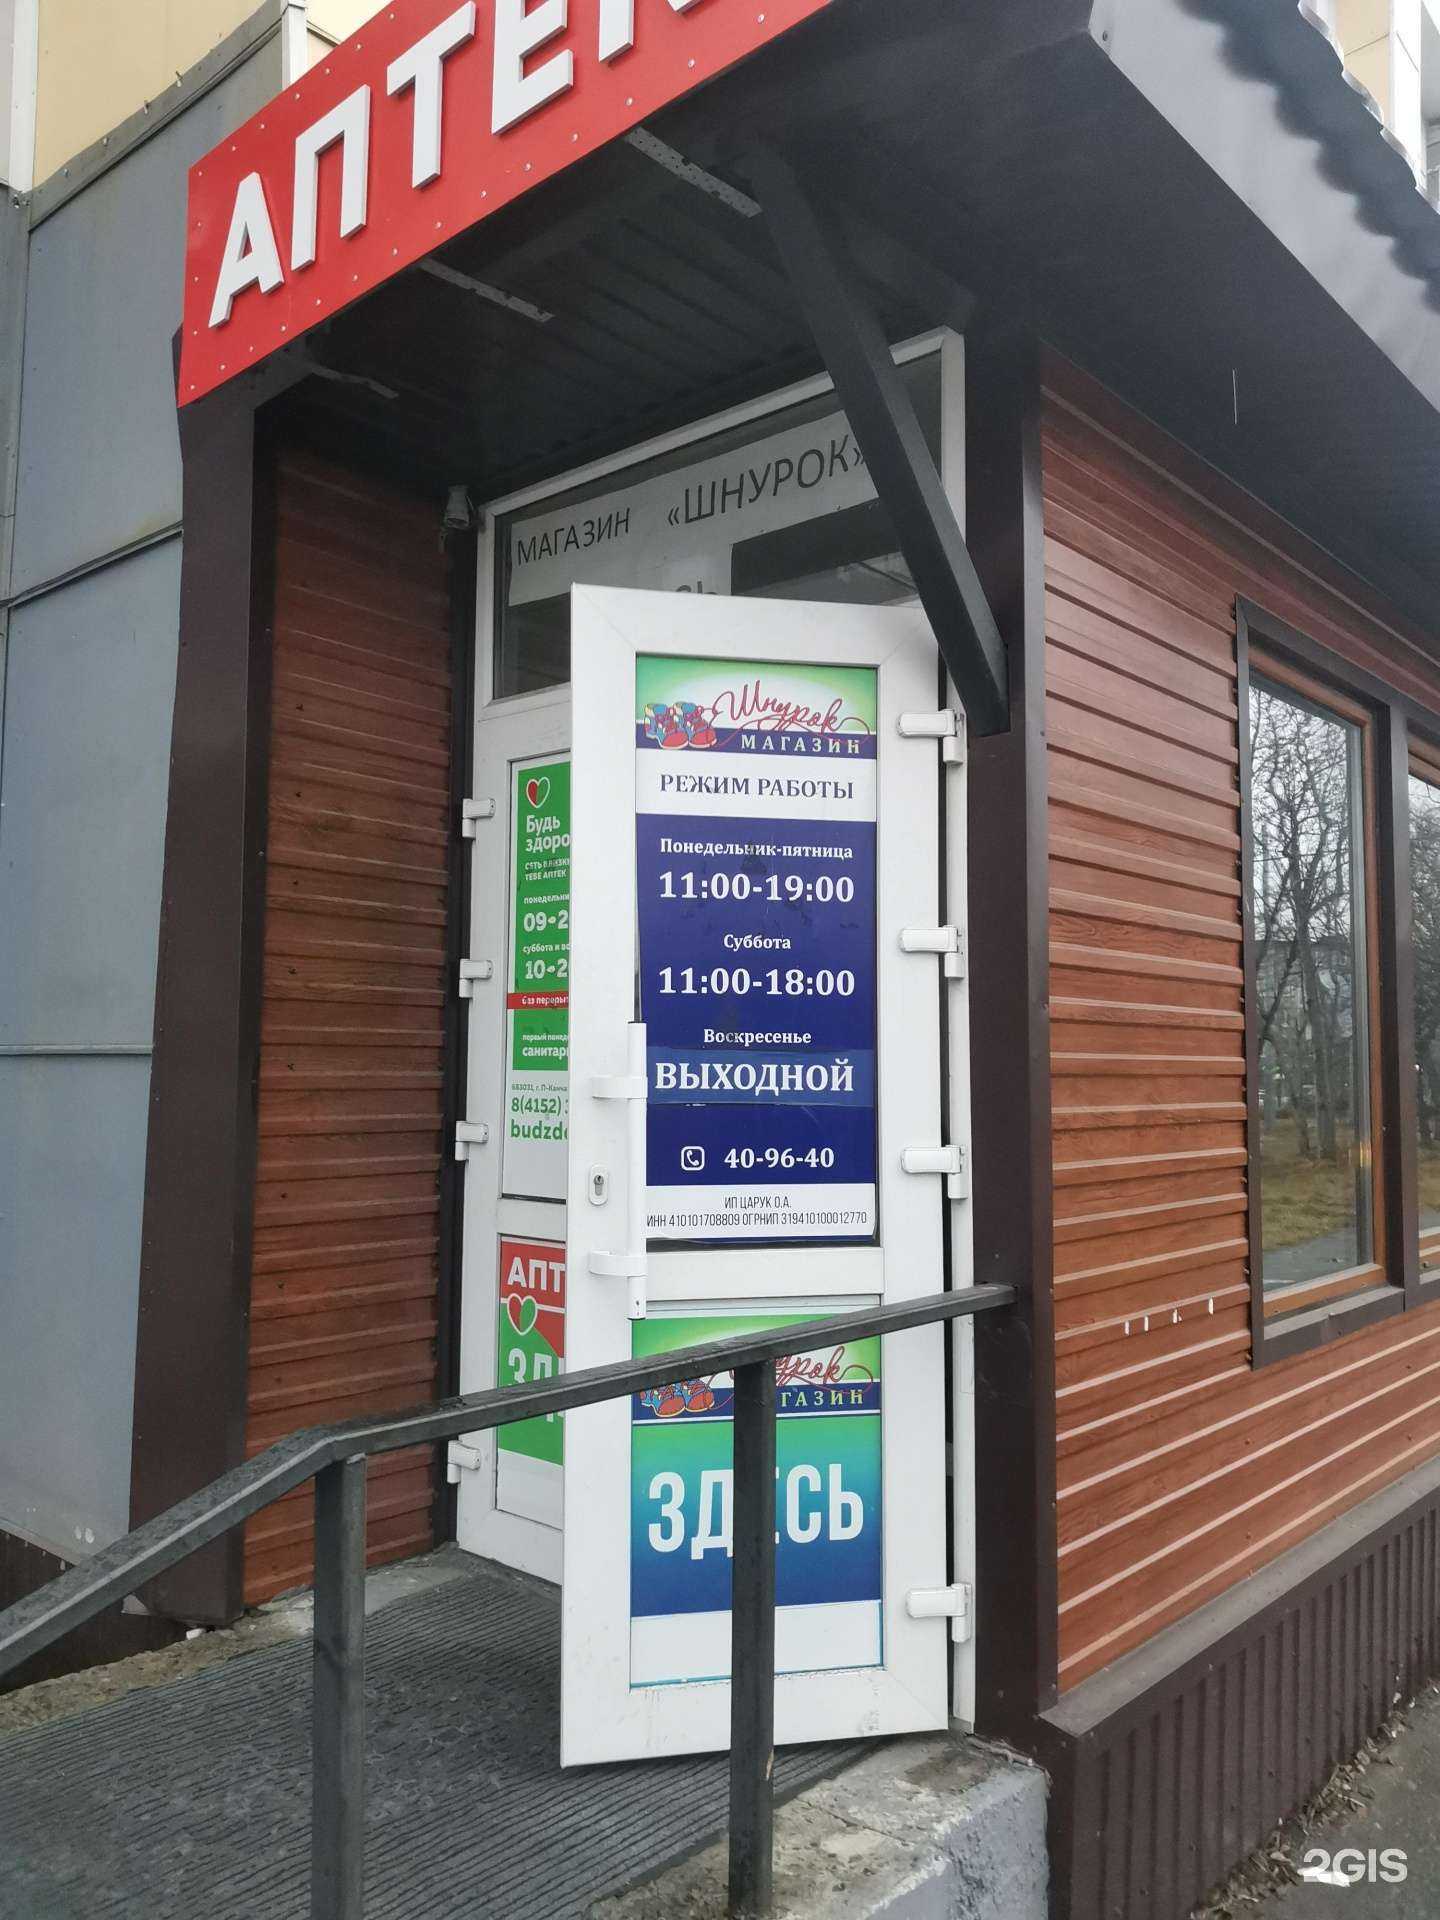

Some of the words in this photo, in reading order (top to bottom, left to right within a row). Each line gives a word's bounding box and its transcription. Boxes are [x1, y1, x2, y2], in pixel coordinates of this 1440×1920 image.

[208, 0, 702, 329] АПТЕ
[517, 507, 631, 566] МАГАЗИН
[666, 434, 865, 528] «ШНУРОК»
[741, 734, 860, 754] МАГАЗИН
[660, 774, 750, 795] РЕЖИМ
[757, 778, 854, 800] РАБОТЫ
[526, 814, 561, 836] Будь
[660, 838, 853, 860] Понедельник-пятница
[659, 871, 855, 903] 11:00-19:00
[723, 934, 791, 952] Суббота
[659, 966, 855, 996] 11:00-18:00
[703, 1028, 812, 1046] Воскресенье
[655, 1058, 854, 1095] ВЫХОДНОЙ
[511, 1095, 562, 1116] 8(4152)
[724, 1147, 835, 1169] 40-96-40
[724, 1196, 738, 1209] ИП
[740, 1196, 772, 1209] ЦАРУК
[647, 1214, 667, 1227] ИНН
[742, 1212, 779, 1226] ОГРНИП
[781, 1389, 863, 1407] ГАЗИН
[648, 1463, 864, 1560] ЗДСЬ
